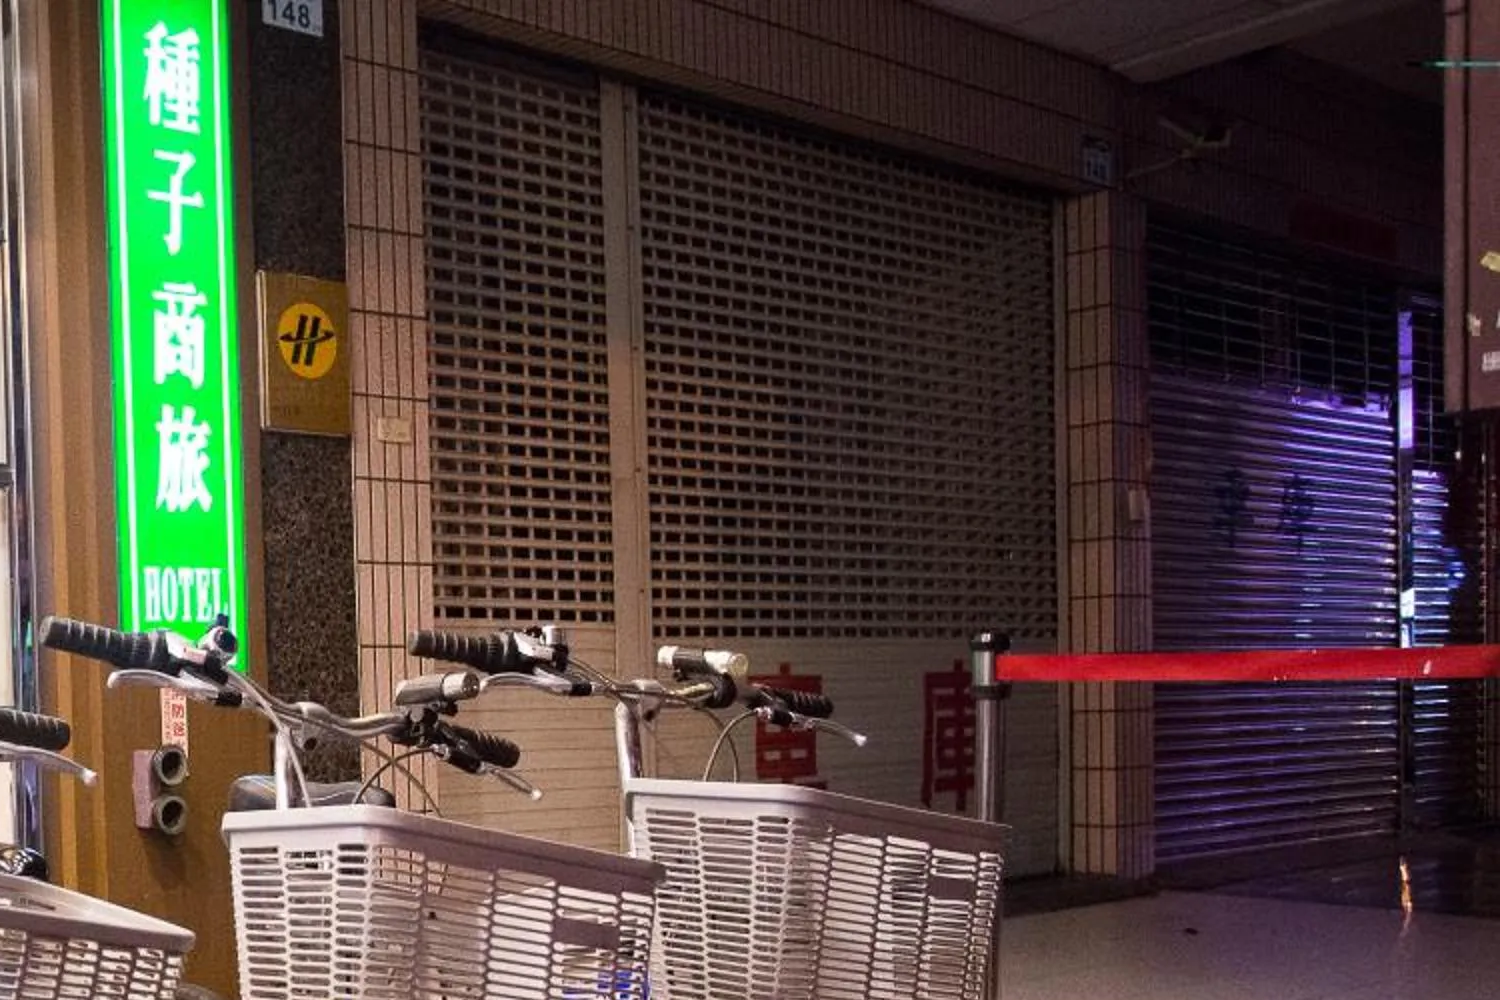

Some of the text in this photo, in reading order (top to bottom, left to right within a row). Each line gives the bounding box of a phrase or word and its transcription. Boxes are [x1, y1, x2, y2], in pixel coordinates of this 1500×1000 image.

[268, 0, 311, 29] 148
[142, 20, 213, 514] 種子商旅
[143, 566, 229, 624] HOTEL
